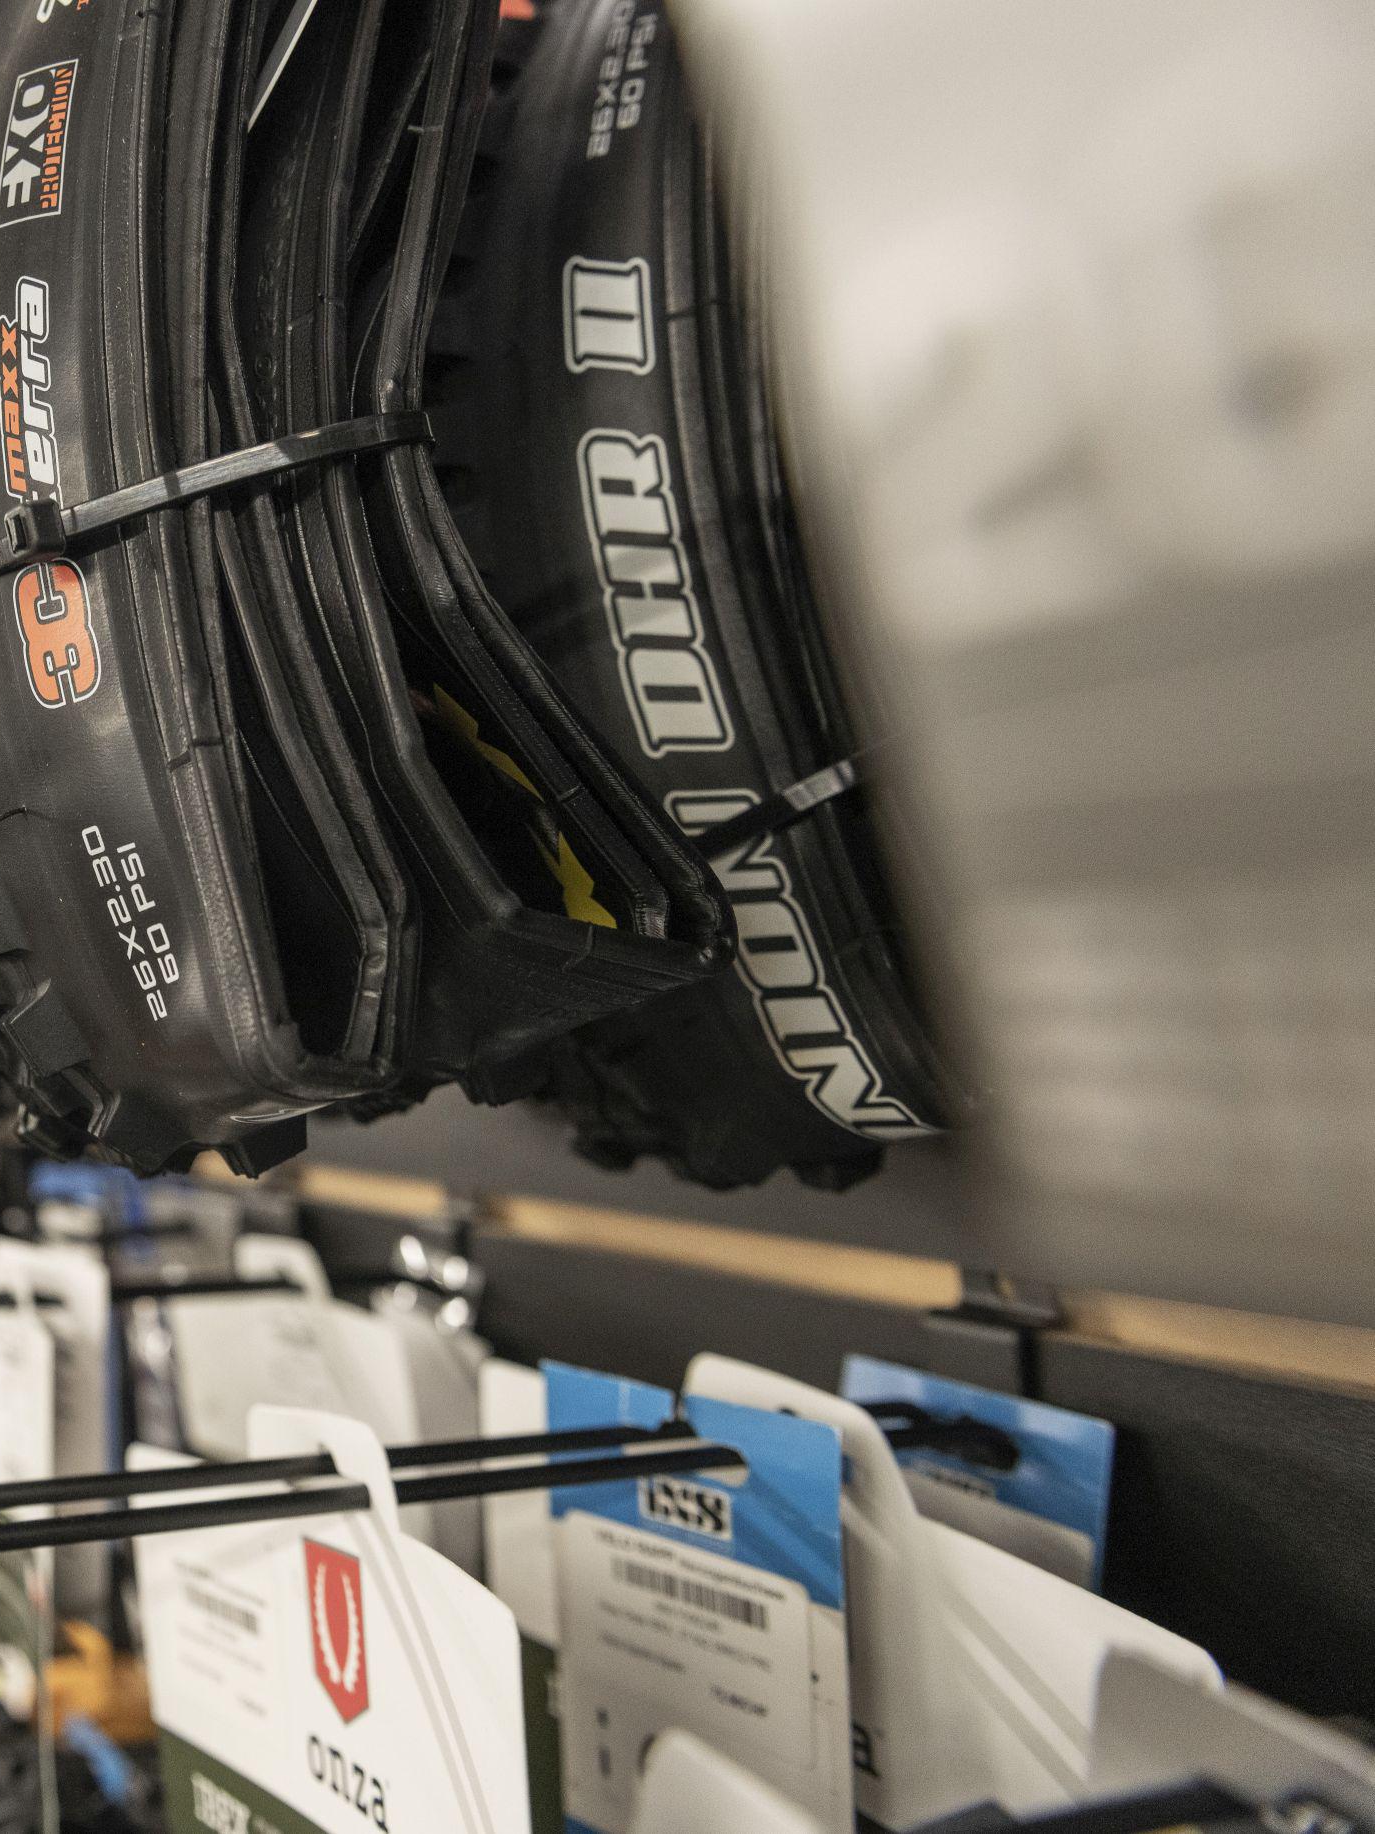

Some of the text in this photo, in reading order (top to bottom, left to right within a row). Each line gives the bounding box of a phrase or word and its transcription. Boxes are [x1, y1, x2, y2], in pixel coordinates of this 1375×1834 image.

[0, 66, 59, 216] EXO
[40, 67, 74, 210] PROTECTION
[19, 278, 61, 503] erra
[563, 255, 656, 375] II
[0, 322, 28, 494] maxx
[13, 557, 102, 709] 3C
[577, 428, 734, 758] DHR
[81, 825, 168, 1022] 26X2.30
[116, 841, 181, 986] 60 PSI
[307, 1734, 391, 1834] onza
